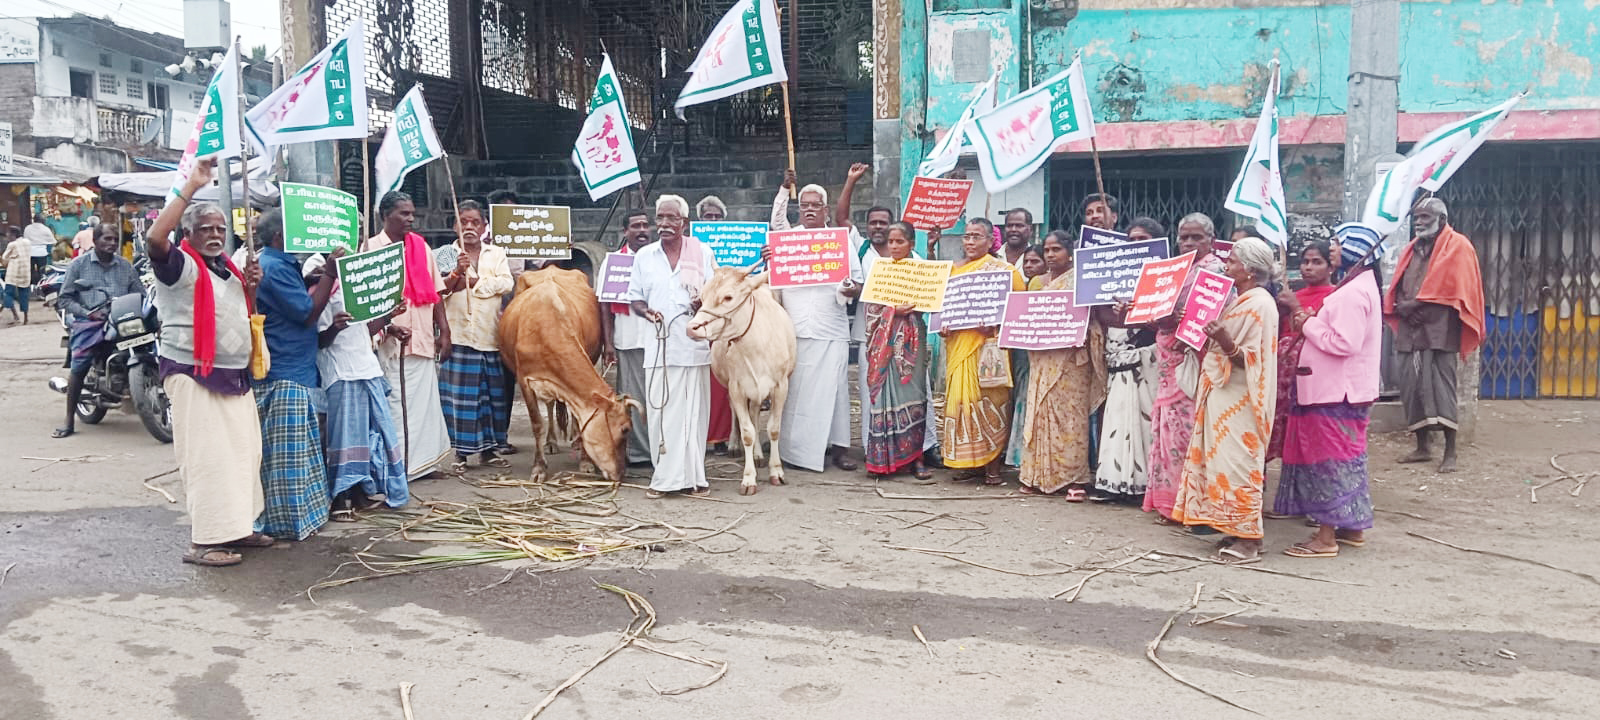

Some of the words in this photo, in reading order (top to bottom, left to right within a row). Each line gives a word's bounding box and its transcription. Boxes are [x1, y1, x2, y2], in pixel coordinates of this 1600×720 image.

[285, 187, 316, 197] உரிய
[513, 208, 549, 219] பாலுக்கு
[508, 220, 554, 231] ஆண்டுக்கு
[494, 234, 513, 244] ஒரு
[514, 235, 540, 244] முறை
[542, 234, 568, 243] விலை
[813, 232, 836, 240] லிட்டர்
[292, 237, 328, 249] உறுதி
[503, 246, 537, 255] ர்ணயம்
[822, 251, 844, 259] லிட்டர்
[1093, 246, 1150, 260] பாலுக்கான
[1082, 270, 1111, 279] லிட்டர்
[1113, 268, 1140, 279] ஒன்று
[1101, 279, 1136, 292] ரூ.10
